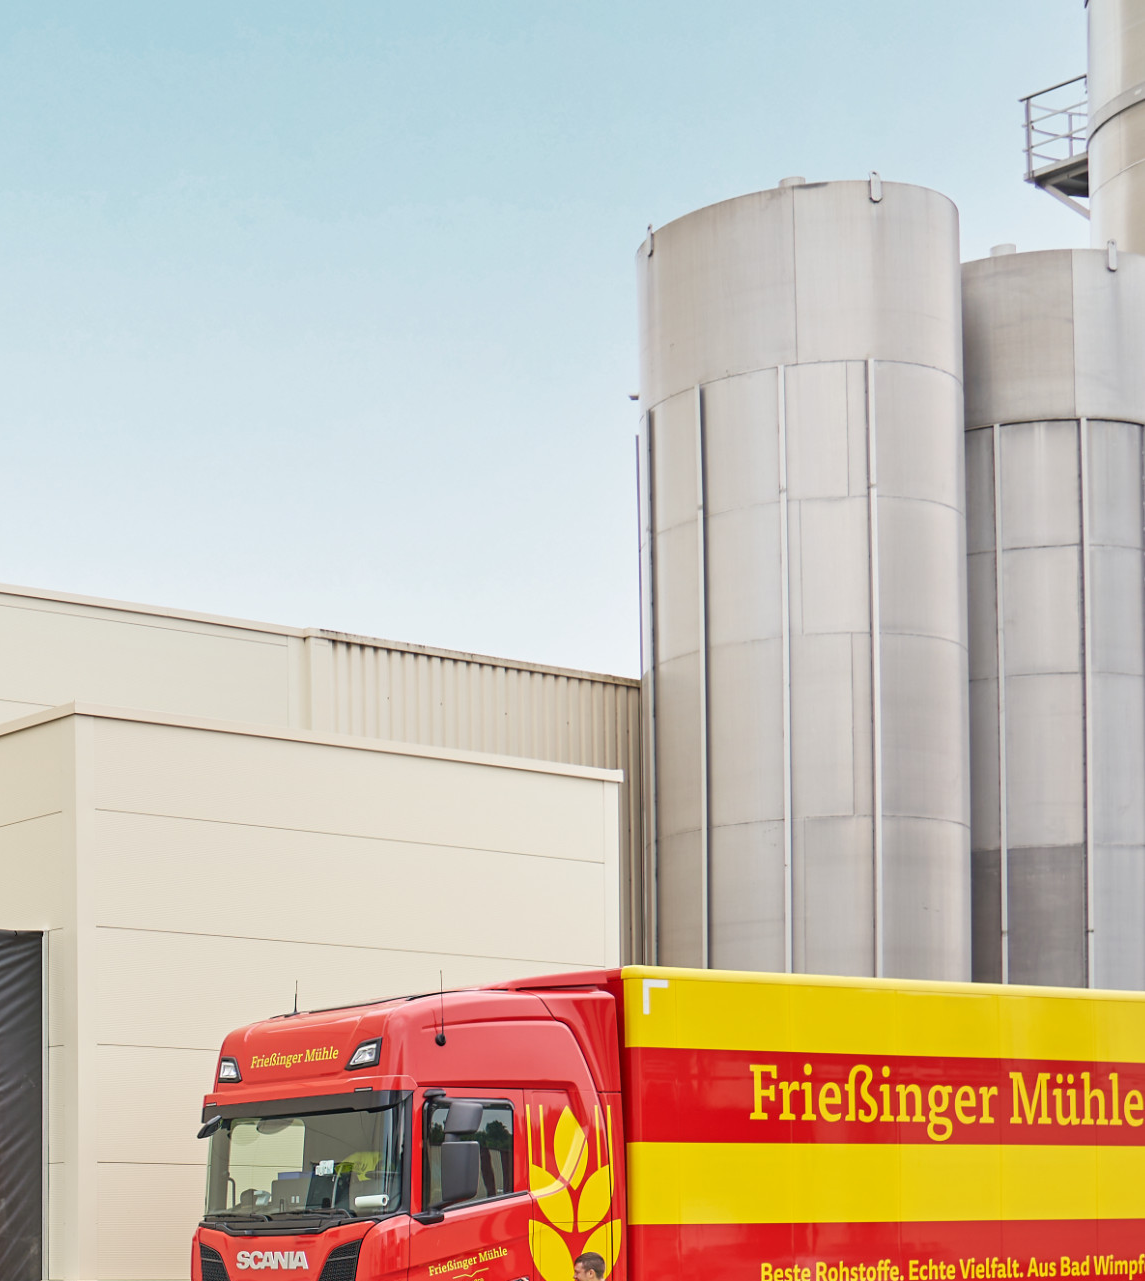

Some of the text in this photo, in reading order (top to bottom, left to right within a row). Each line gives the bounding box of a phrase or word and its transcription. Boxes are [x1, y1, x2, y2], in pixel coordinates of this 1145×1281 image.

[250, 1045, 339, 1069] Frießinger Mühle
[749, 1063, 1144, 1142] Frießinger Mühle
[236, 1250, 309, 1270] SCANIA
[428, 1246, 508, 1276] Frießinger Mühle
[908, 1258, 956, 1281] Echte
[959, 1256, 1024, 1279] Vielfalt.
[1027, 1256, 1057, 1278] Aus
[1060, 1255, 1090, 1277] Bad
[1093, 1253, 1145, 1281] Wimpf
